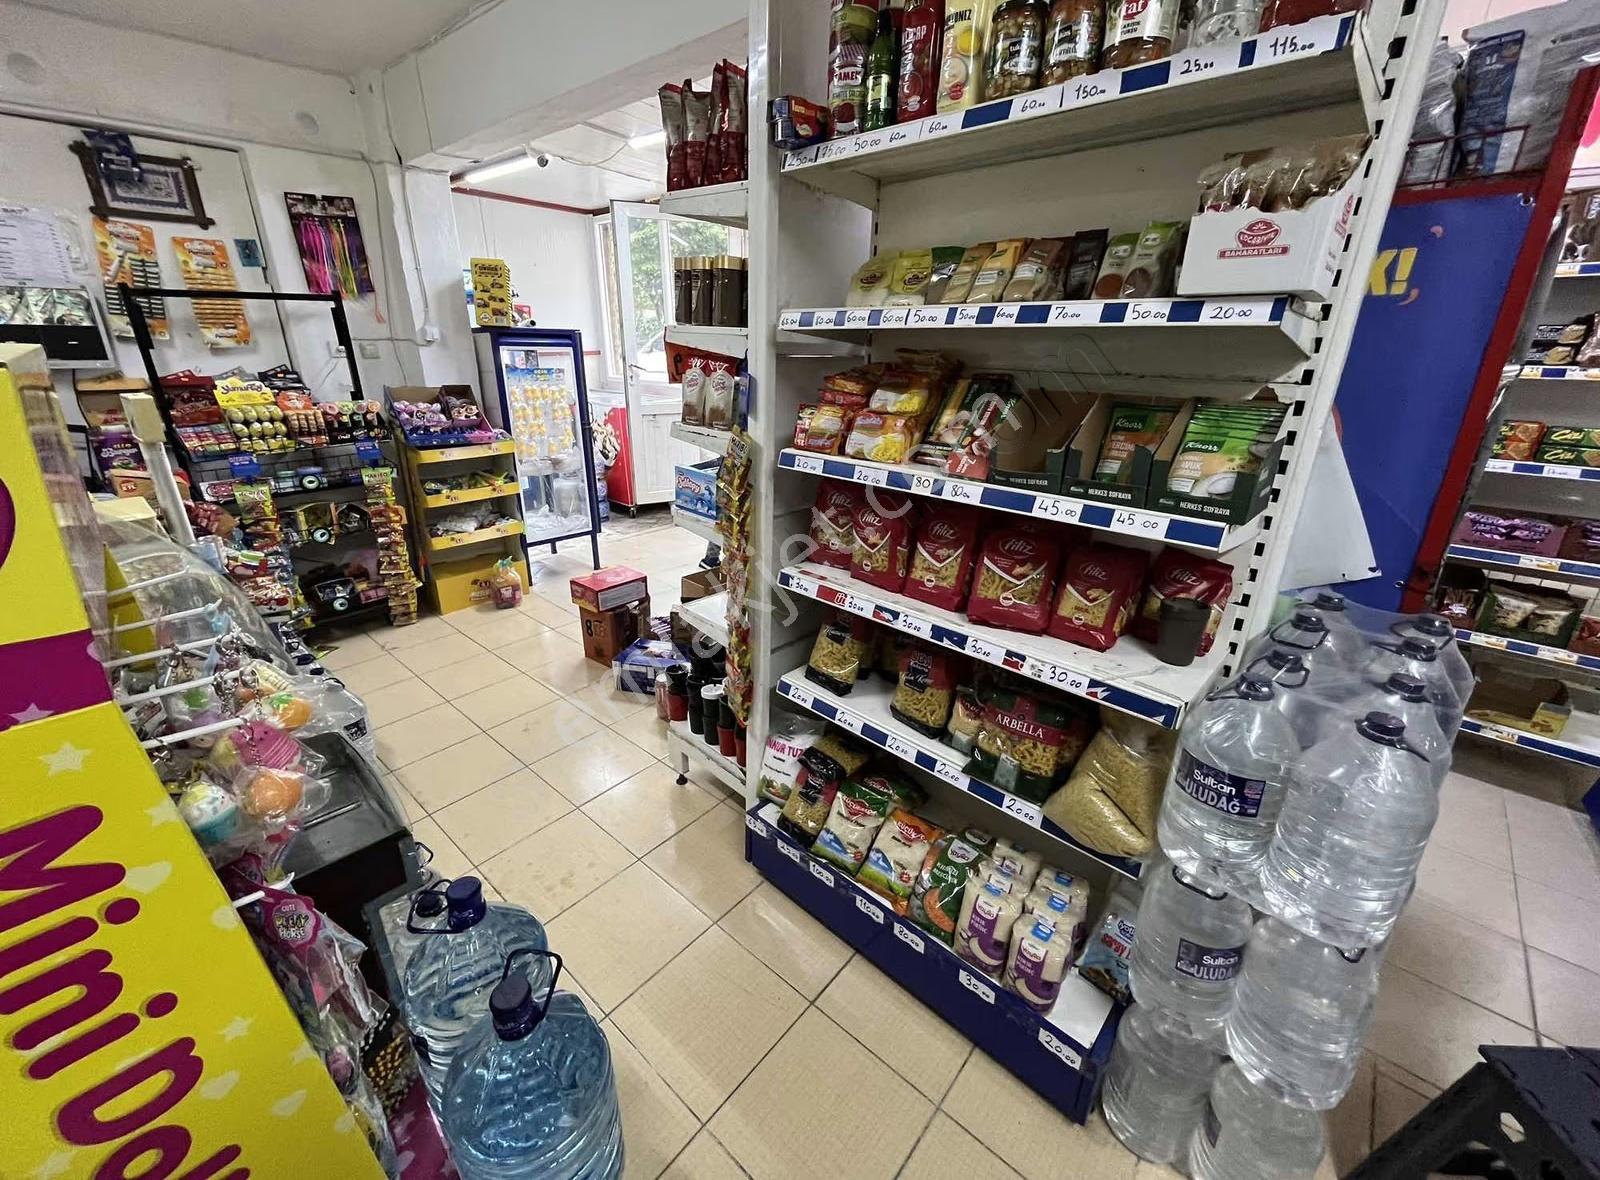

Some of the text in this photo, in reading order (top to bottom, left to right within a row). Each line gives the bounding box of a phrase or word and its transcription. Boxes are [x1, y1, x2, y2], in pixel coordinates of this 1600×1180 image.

[1269, 36, 1315, 57] 115.00
[1180, 59, 1215, 75] 25.00
[1223, 246, 1282, 257] BAHARATLARI
[913, 311, 938, 324] 50.00
[1054, 306, 1082, 320] 70.00
[1132, 303, 1167, 320] 50.00
[1209, 305, 1253, 320] 20.00
[1115, 417, 1143, 431] Knorr
[1184, 440, 1219, 453] Knorr
[857, 469, 881, 485] 20.00
[915, 475, 931, 489] 80
[1088, 488, 1108, 499] HERKES
[1109, 489, 1132, 501] SOFRAYA
[1038, 499, 1077, 519] 45.00
[1180, 501, 1202, 512] HERKES
[1203, 504, 1231, 516] SOFRAYA
[862, 512, 884, 526] filiz
[1116, 512, 1159, 530] 45.00
[933, 524, 956, 539] filiz
[1004, 539, 1037, 556] filiz
[1082, 564, 1108, 581] filiz
[1171, 569, 1199, 585] filiz
[902, 615, 922, 633] 30.00
[970, 640, 991, 658] 30.00
[1050, 665, 1082, 689] 30.00
[792, 687, 808, 704] 20.00
[838, 711, 854, 728] 20.00
[995, 712, 1045, 740] ARBELLA
[890, 737, 908, 755] 20.00
[934, 763, 960, 782] 20.00
[1192, 768, 1236, 796] Sultan
[1185, 777, 1241, 814] ULUDAĞ
[1004, 798, 1035, 821] 20.00
[279, 926, 305, 940] HORSE
[897, 925, 920, 948] 80.00
[1202, 954, 1238, 966] Sultan
[0, 804, 251, 1180] Mini Dol
[965, 973, 991, 999] 30.00
[1043, 1034, 1076, 1064] 20.00
